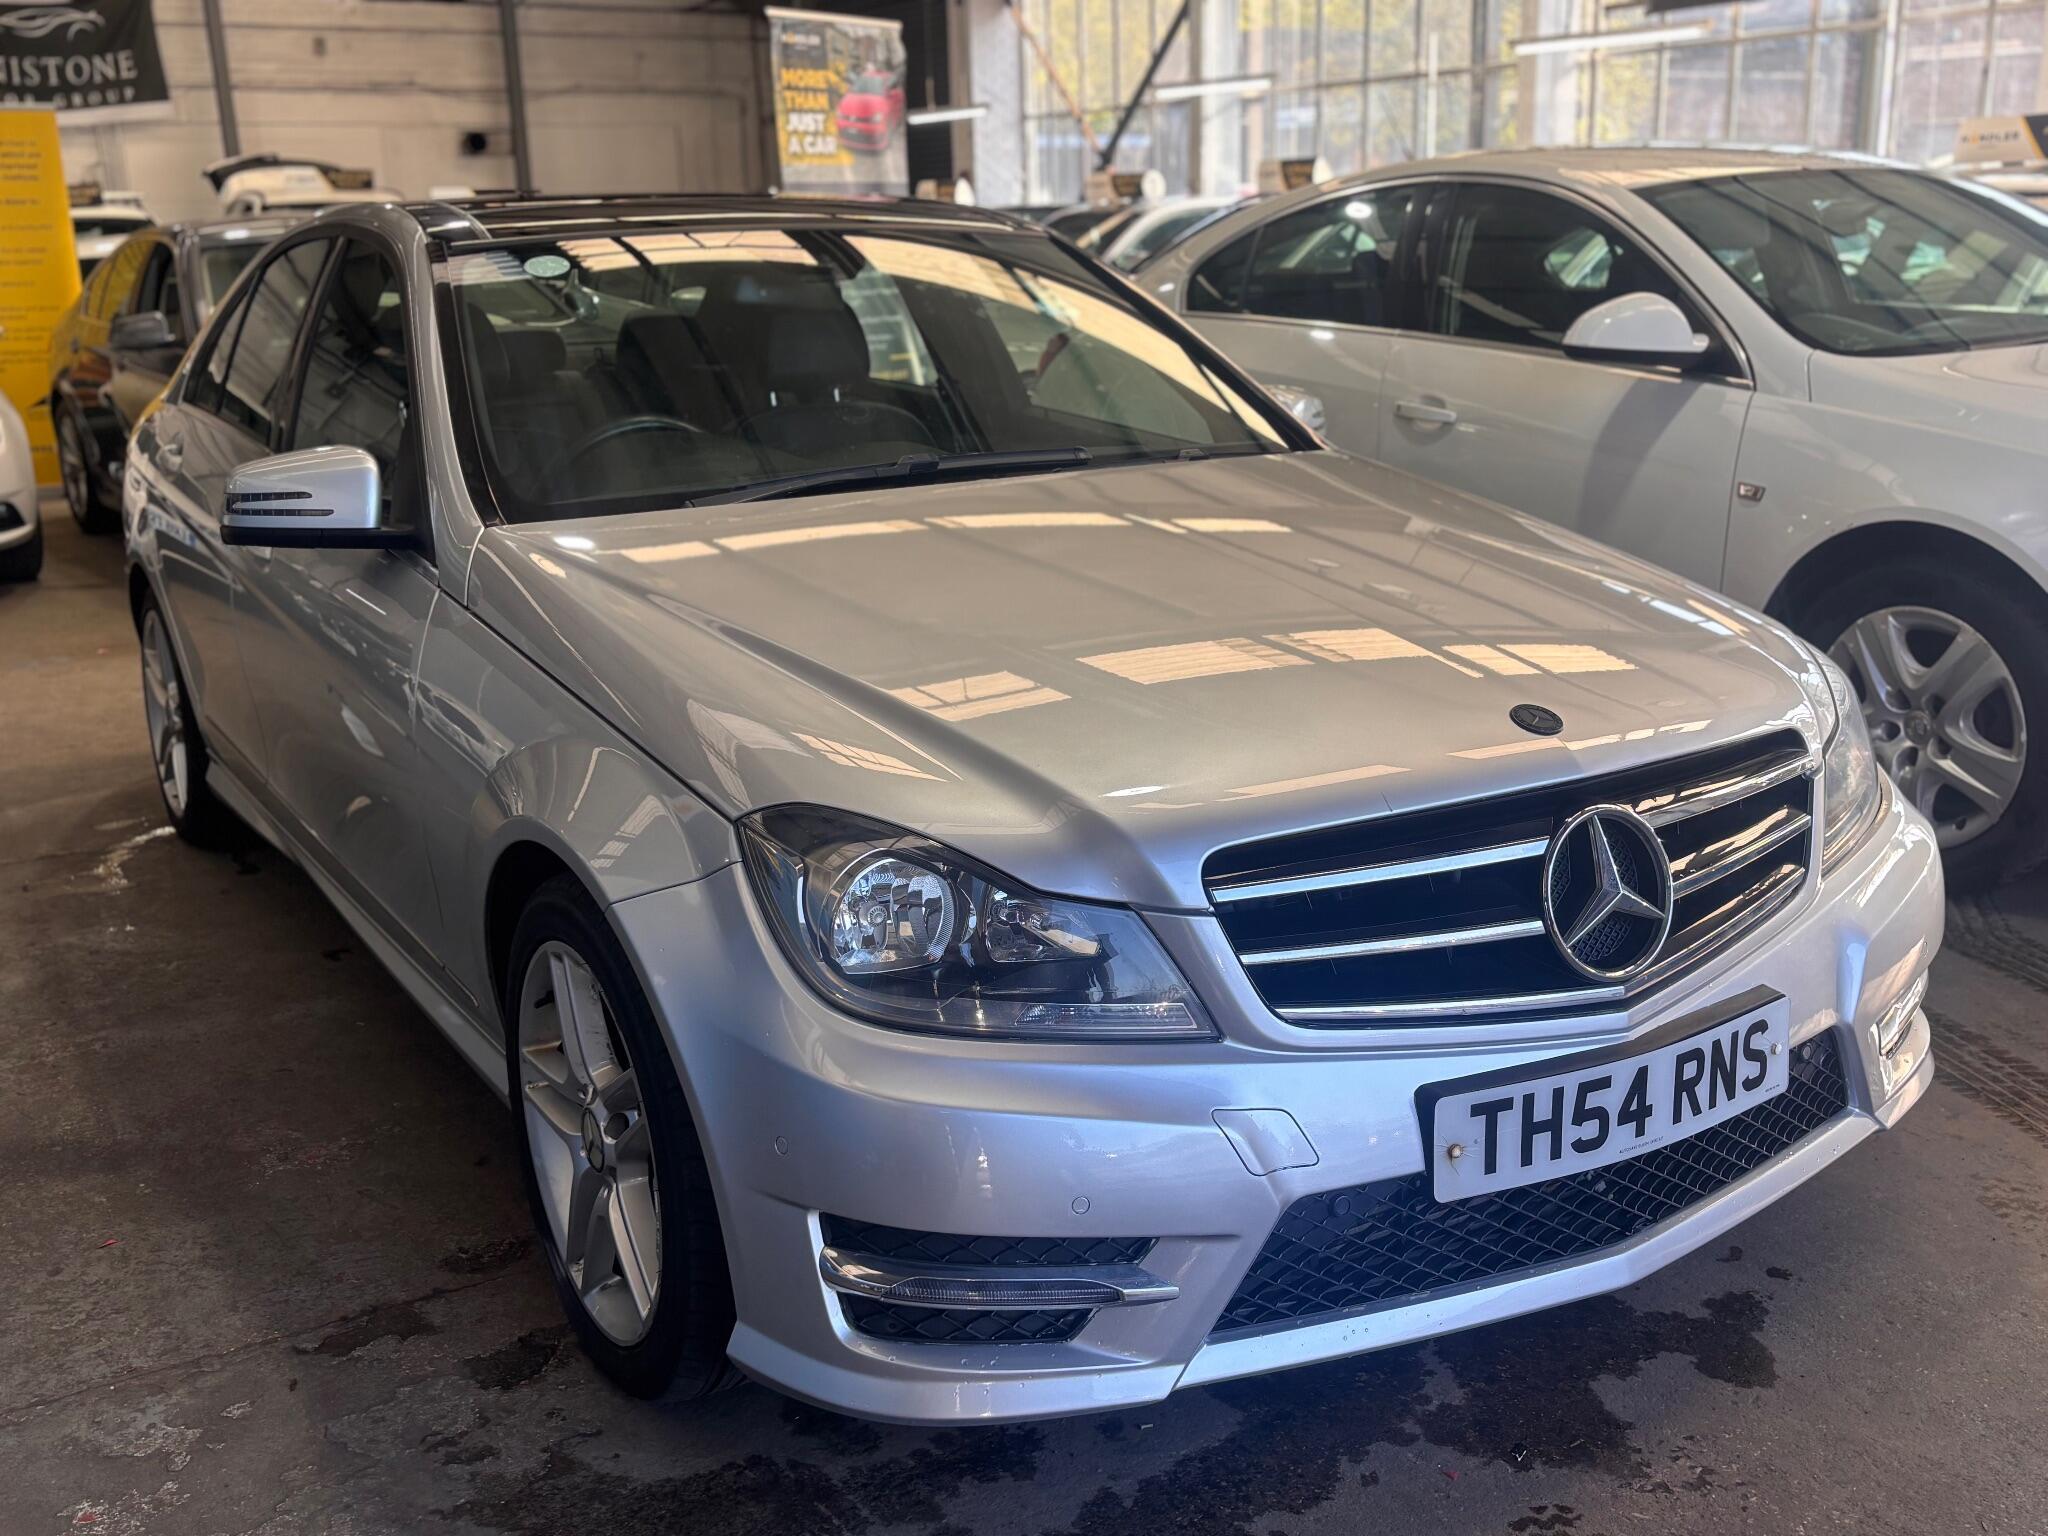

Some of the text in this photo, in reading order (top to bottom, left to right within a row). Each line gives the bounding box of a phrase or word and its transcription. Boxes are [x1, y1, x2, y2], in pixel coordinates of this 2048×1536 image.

[53, 85, 136, 109] GROUP
[786, 111, 826, 132] JUST
[788, 136, 837, 155] A CAR
[1470, 1018, 1769, 1176] TH54 RNS
